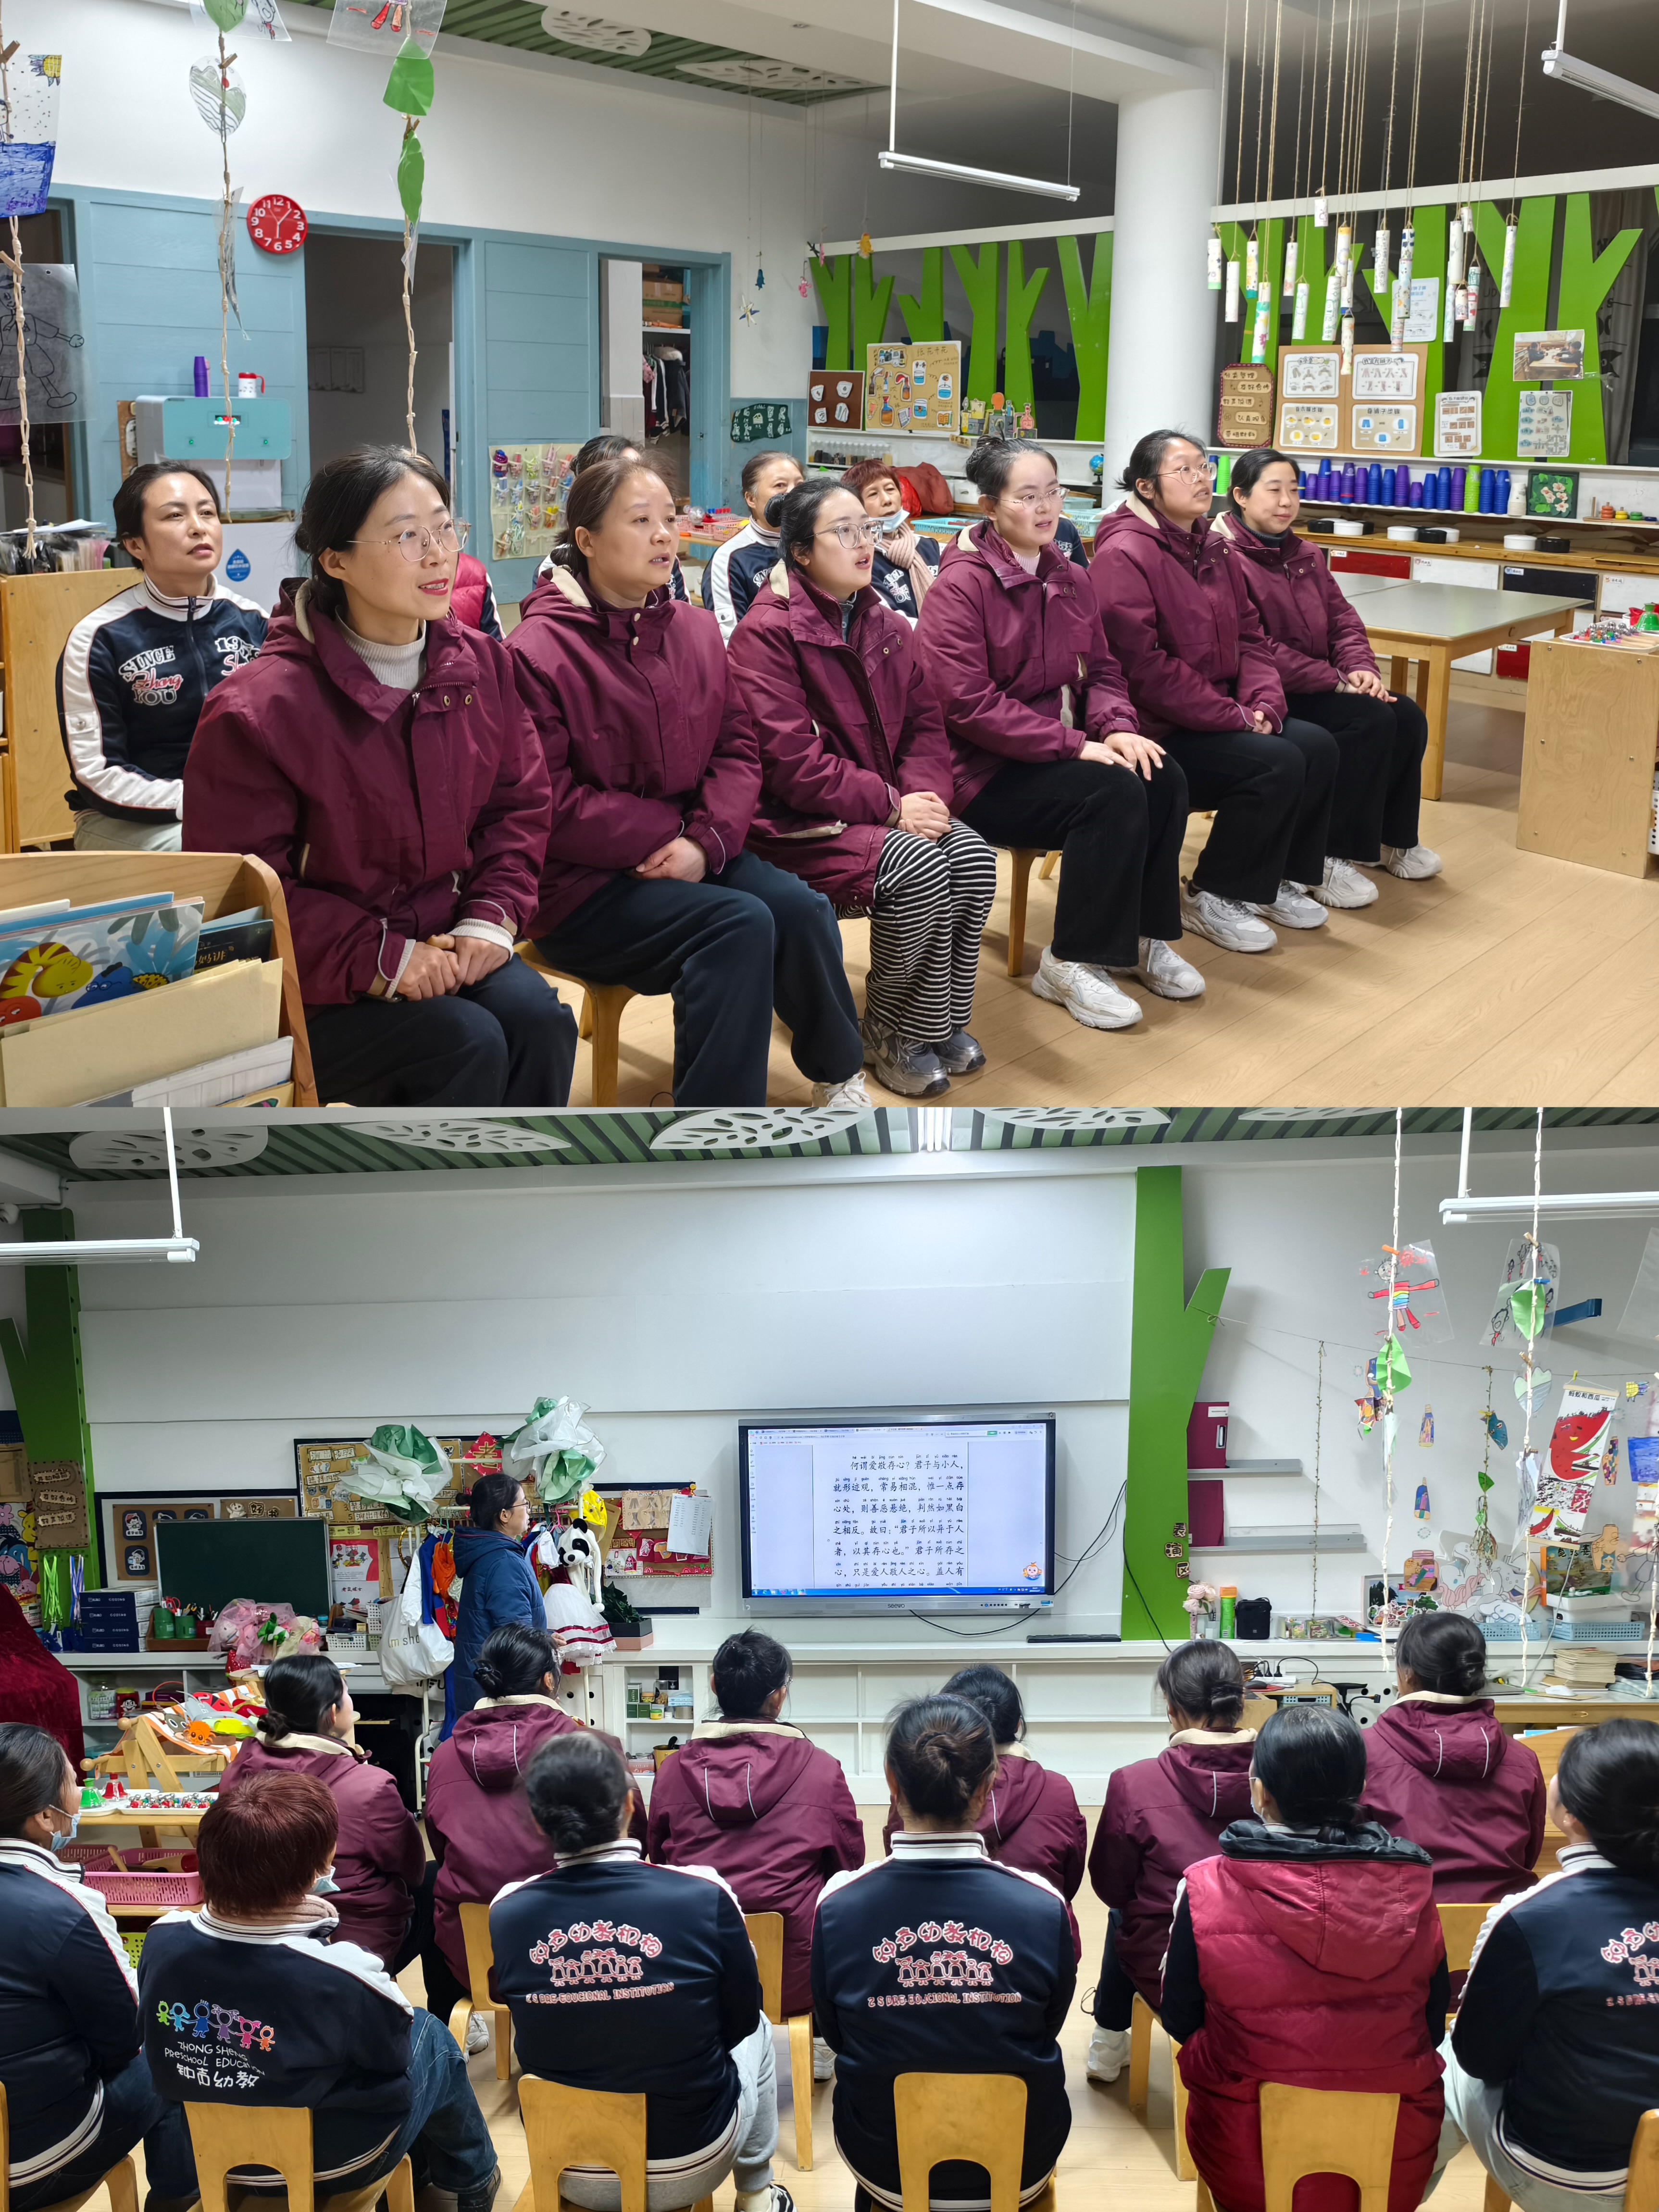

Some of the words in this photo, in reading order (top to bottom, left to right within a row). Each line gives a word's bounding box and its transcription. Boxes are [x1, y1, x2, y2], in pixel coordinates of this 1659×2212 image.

[262, 199, 271, 209] 11
[272, 197, 285, 206] 12
[286, 201, 291, 209] 1
[254, 208, 266, 217] 10
[293, 210, 301, 219] 2
[251, 217, 259, 226] 9
[296, 222, 305, 231] 3
[254, 228, 263, 238] 8
[292, 232, 301, 242] 4
[264, 237, 272, 247] 7
[274, 242, 282, 251] 6
[285, 240, 293, 249] 5
[118, 646, 176, 683] SINCE
[132, 688, 177, 706] YOU
[1568, 1391, 1600, 1401] 蚂蚁和西瓜
[177, 2041, 213, 2054] ZHONG
[176, 2063, 260, 2089] 钟声幼教
